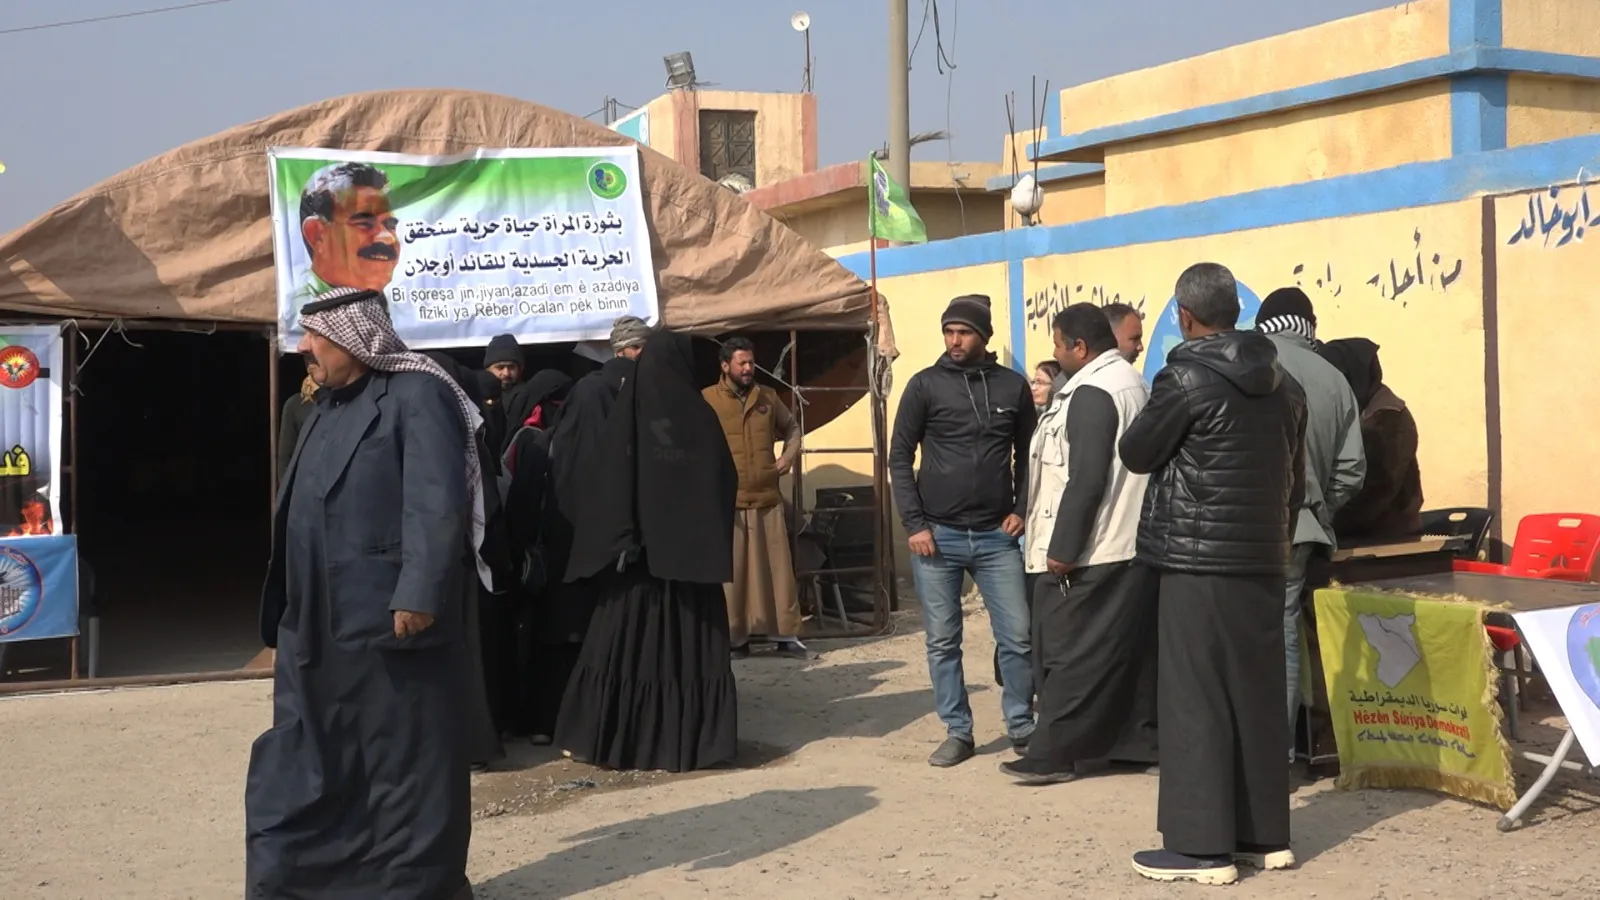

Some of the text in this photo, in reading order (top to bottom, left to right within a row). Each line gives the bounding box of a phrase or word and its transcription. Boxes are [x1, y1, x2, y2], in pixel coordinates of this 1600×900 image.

[404, 211, 622, 244] بثورة المرأة حياة حرية سنحقق
[404, 252, 455, 277] أوجلان
[509, 251, 576, 275] الجسدية
[579, 249, 631, 271] الحرية
[391, 287, 405, 302] Bi
[554, 284, 573, 295] em
[453, 306, 469, 322] ya
[519, 300, 565, 315] Ocalan
